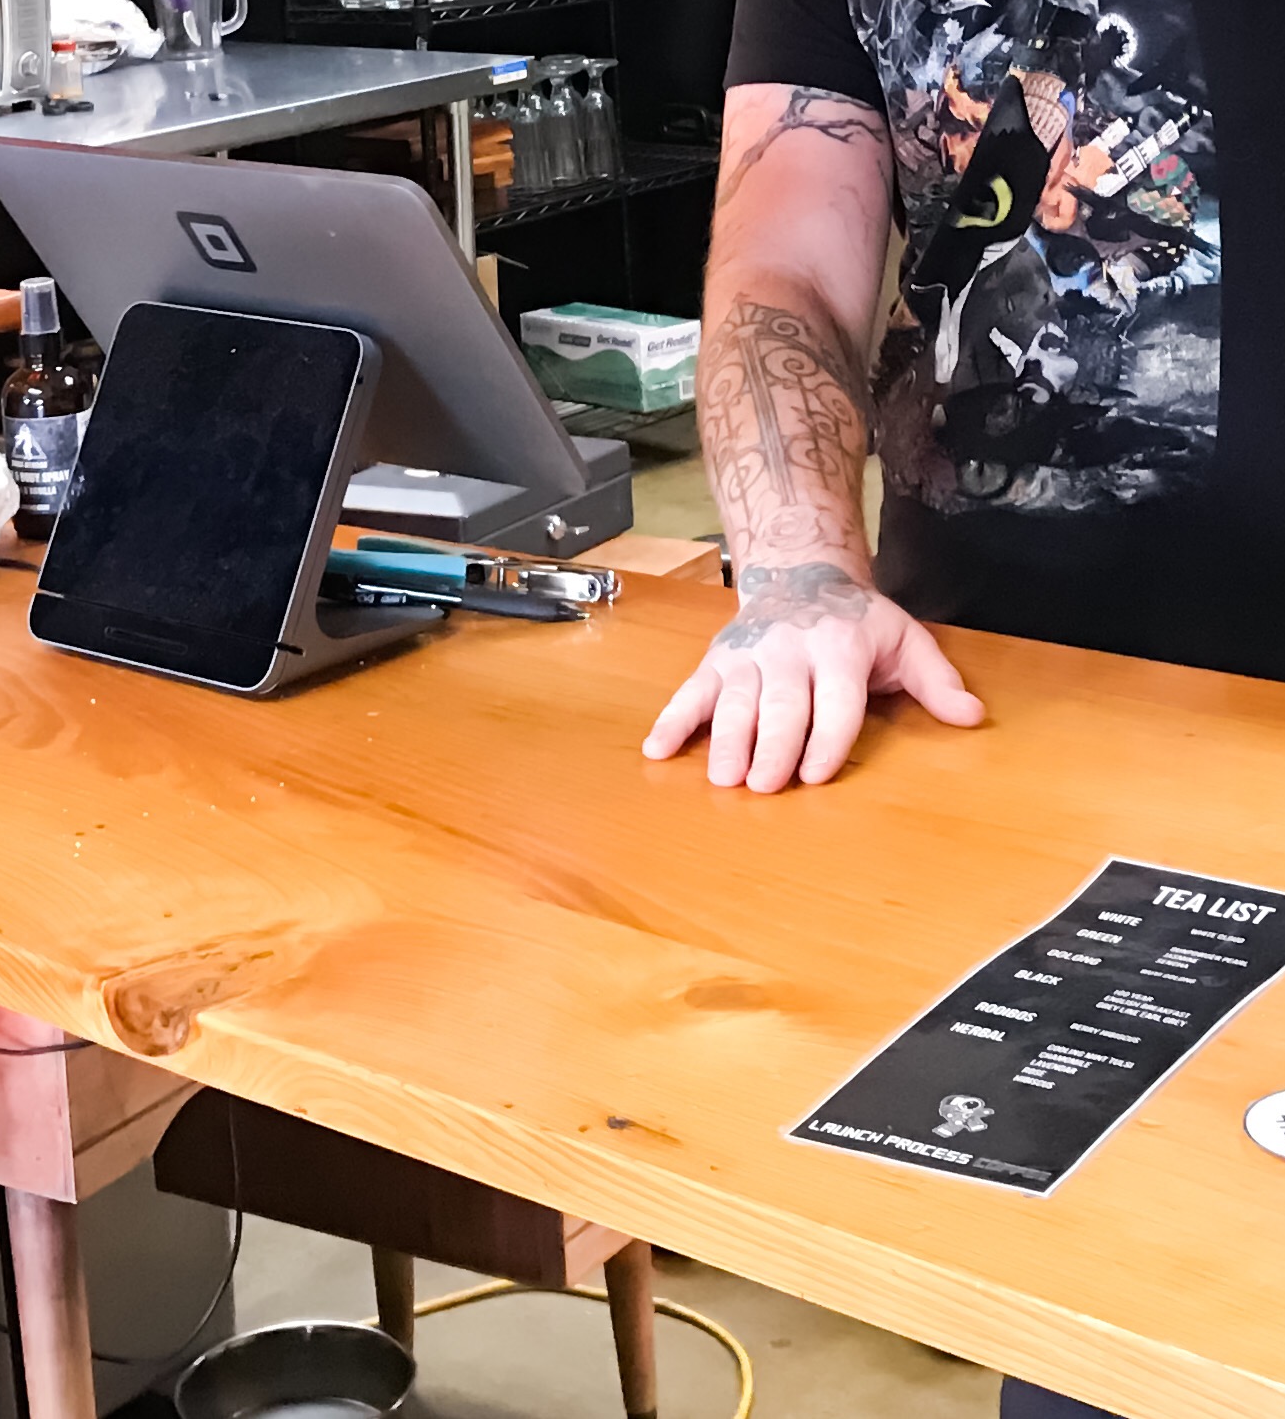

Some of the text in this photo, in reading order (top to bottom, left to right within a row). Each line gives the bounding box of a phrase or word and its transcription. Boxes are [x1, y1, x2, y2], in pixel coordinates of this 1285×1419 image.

[1153, 886, 1276, 925] TEA LIST
[1098, 911, 1143, 927] WHITE
[1076, 929, 1123, 944] GREEN
[1046, 949, 1102, 966] OOLONG
[1014, 969, 1063, 986] BLACK
[974, 1001, 1038, 1022] ROOIBOS
[950, 1022, 1006, 1042] HERBAL
[808, 1120, 884, 1144] LAUNCH
[883, 1134, 974, 1165] PROCESS
